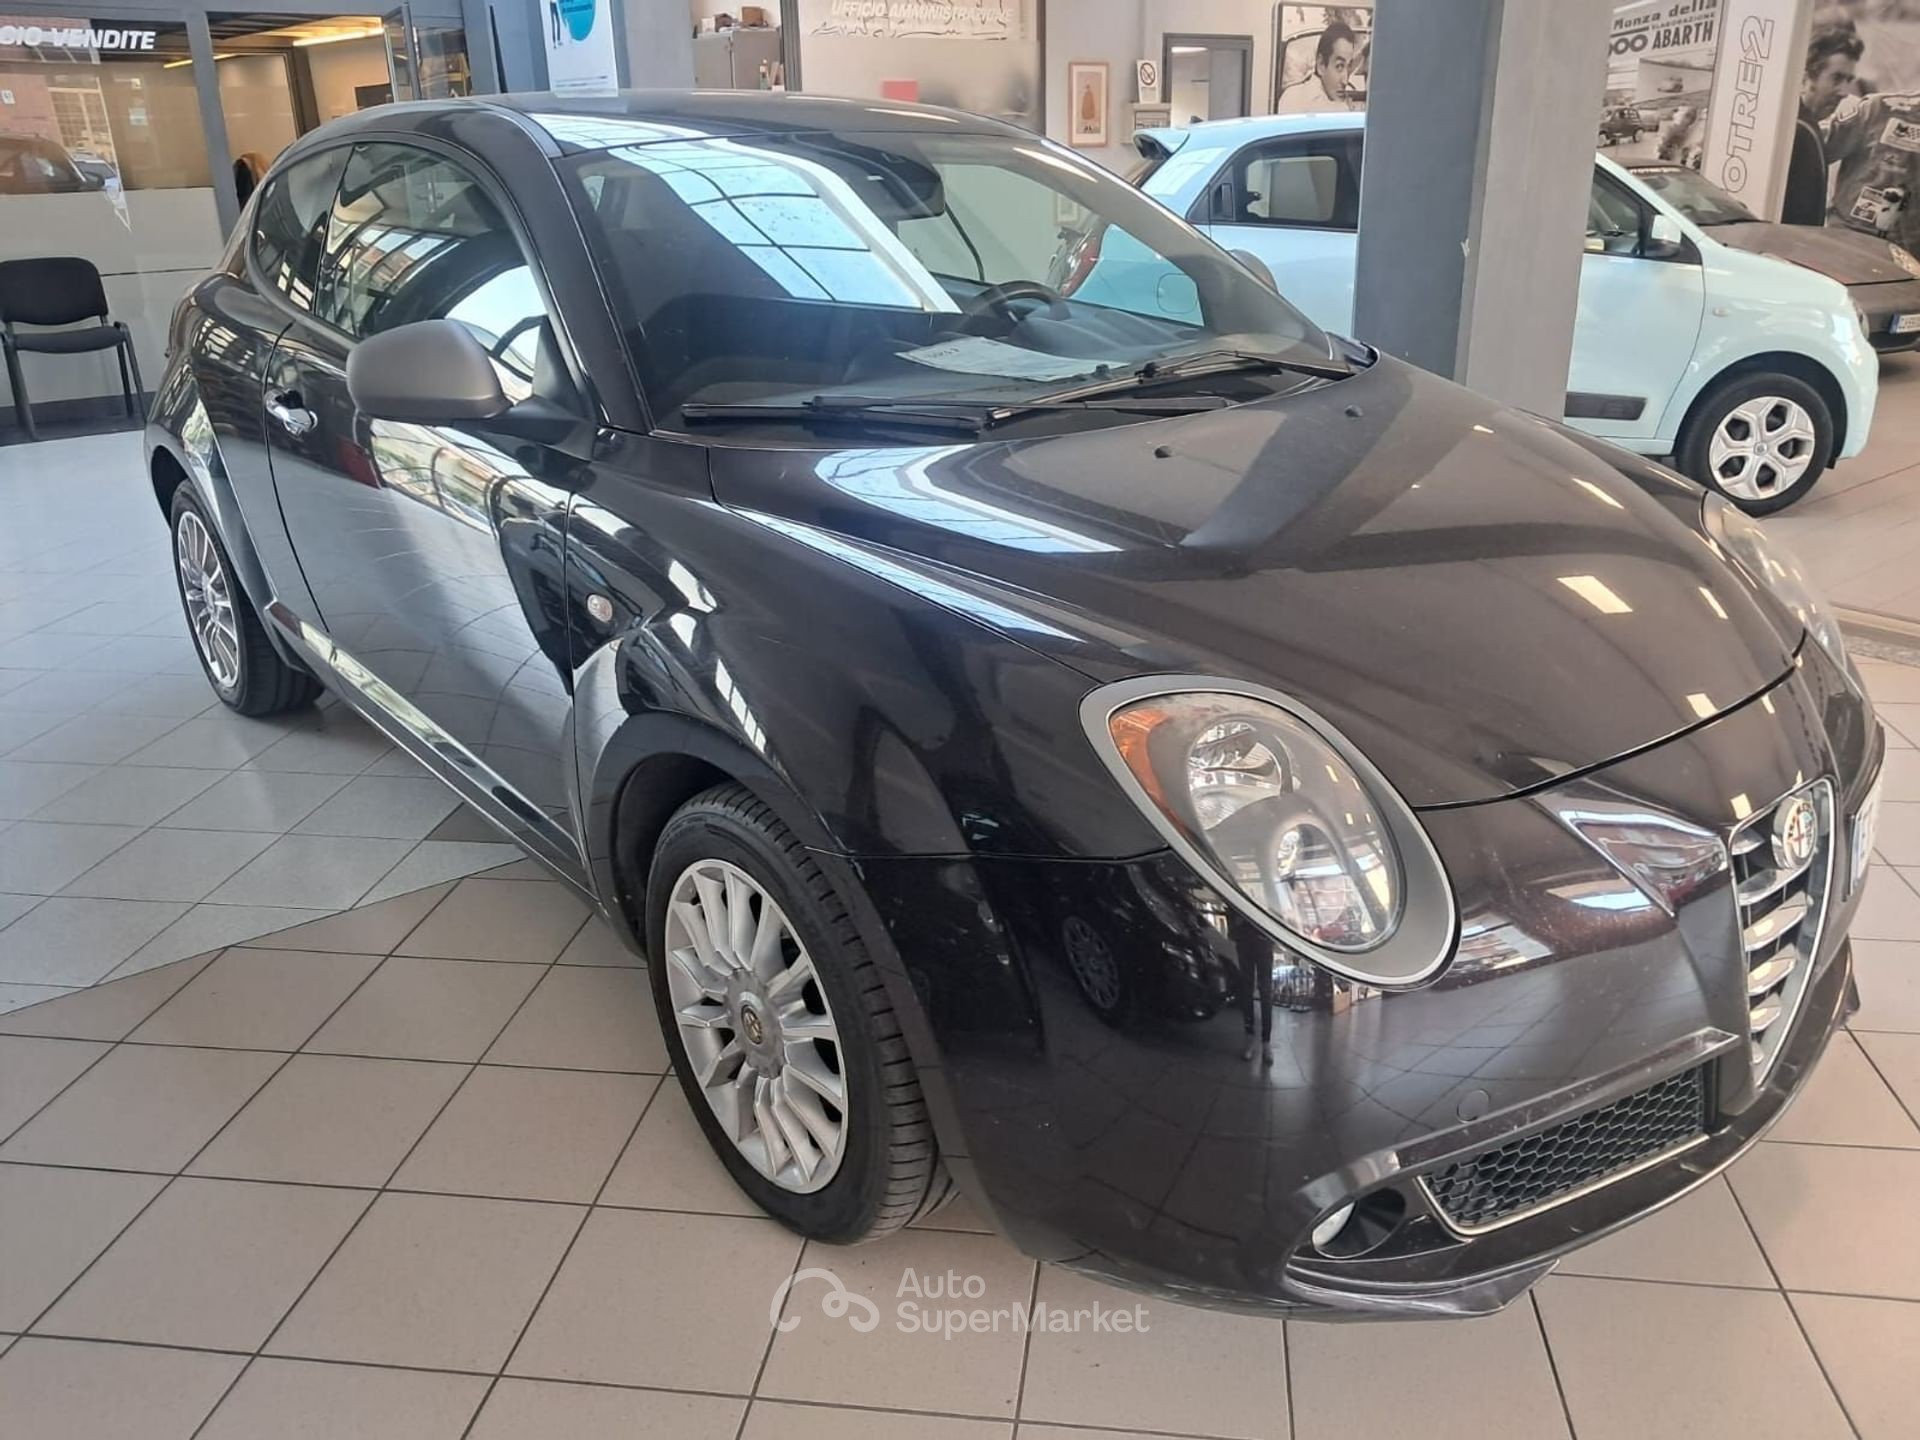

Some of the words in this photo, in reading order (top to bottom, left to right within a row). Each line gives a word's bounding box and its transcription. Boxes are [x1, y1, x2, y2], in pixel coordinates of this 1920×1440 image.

[831, 0, 888, 17] UFFICIO
[1613, 12, 1661, 30] Monza
[51, 28, 156, 50] VENDITE
[1652, 20, 1714, 49] ABARTH
